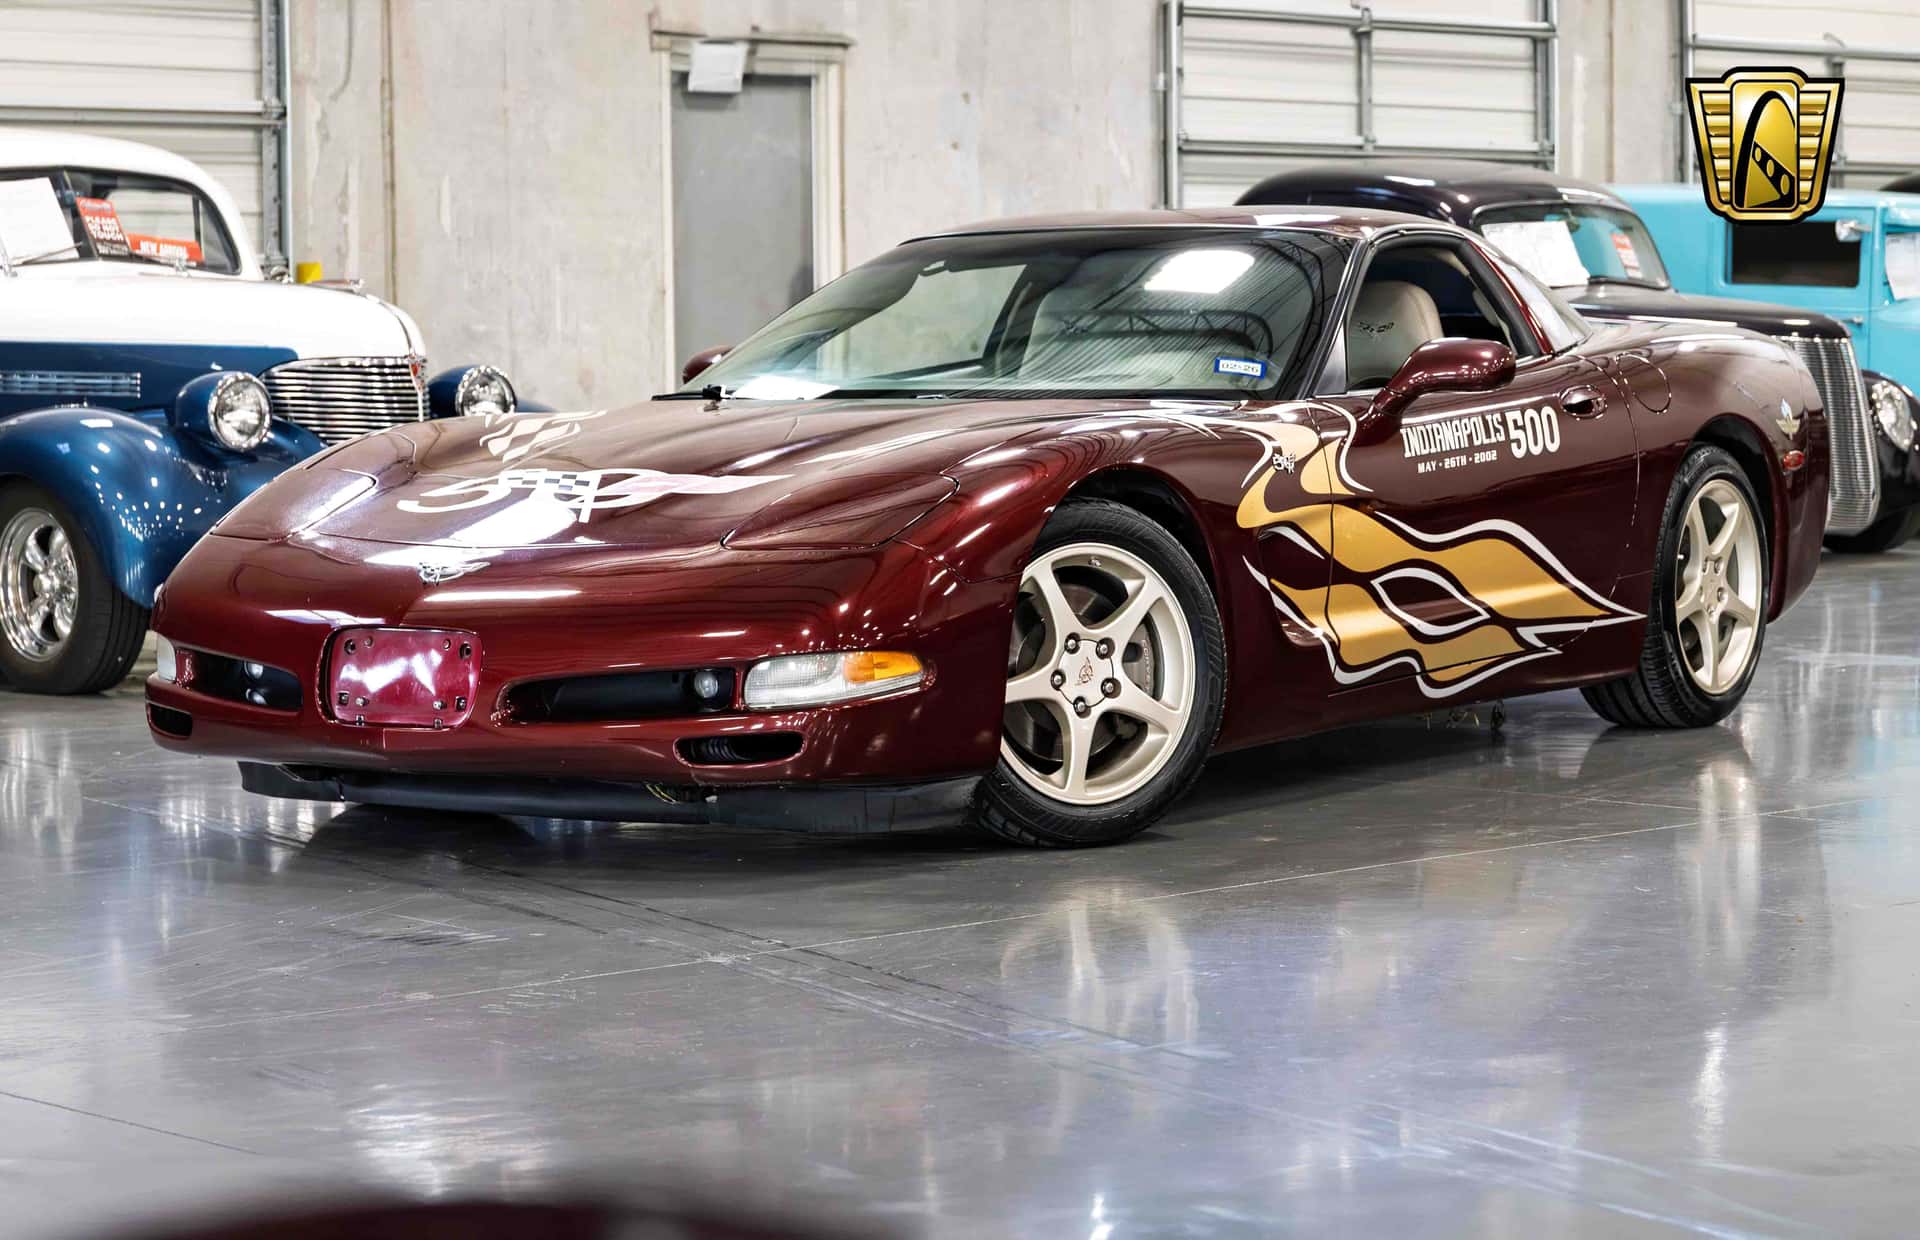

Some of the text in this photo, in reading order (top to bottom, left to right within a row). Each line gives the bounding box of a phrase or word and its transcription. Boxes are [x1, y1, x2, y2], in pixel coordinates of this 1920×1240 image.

[91, 230, 125, 240] TOUCH
[1400, 406, 1561, 459] INDIANAPOLIS 500
[1417, 450, 1498, 473] MAY 26TH 2002
